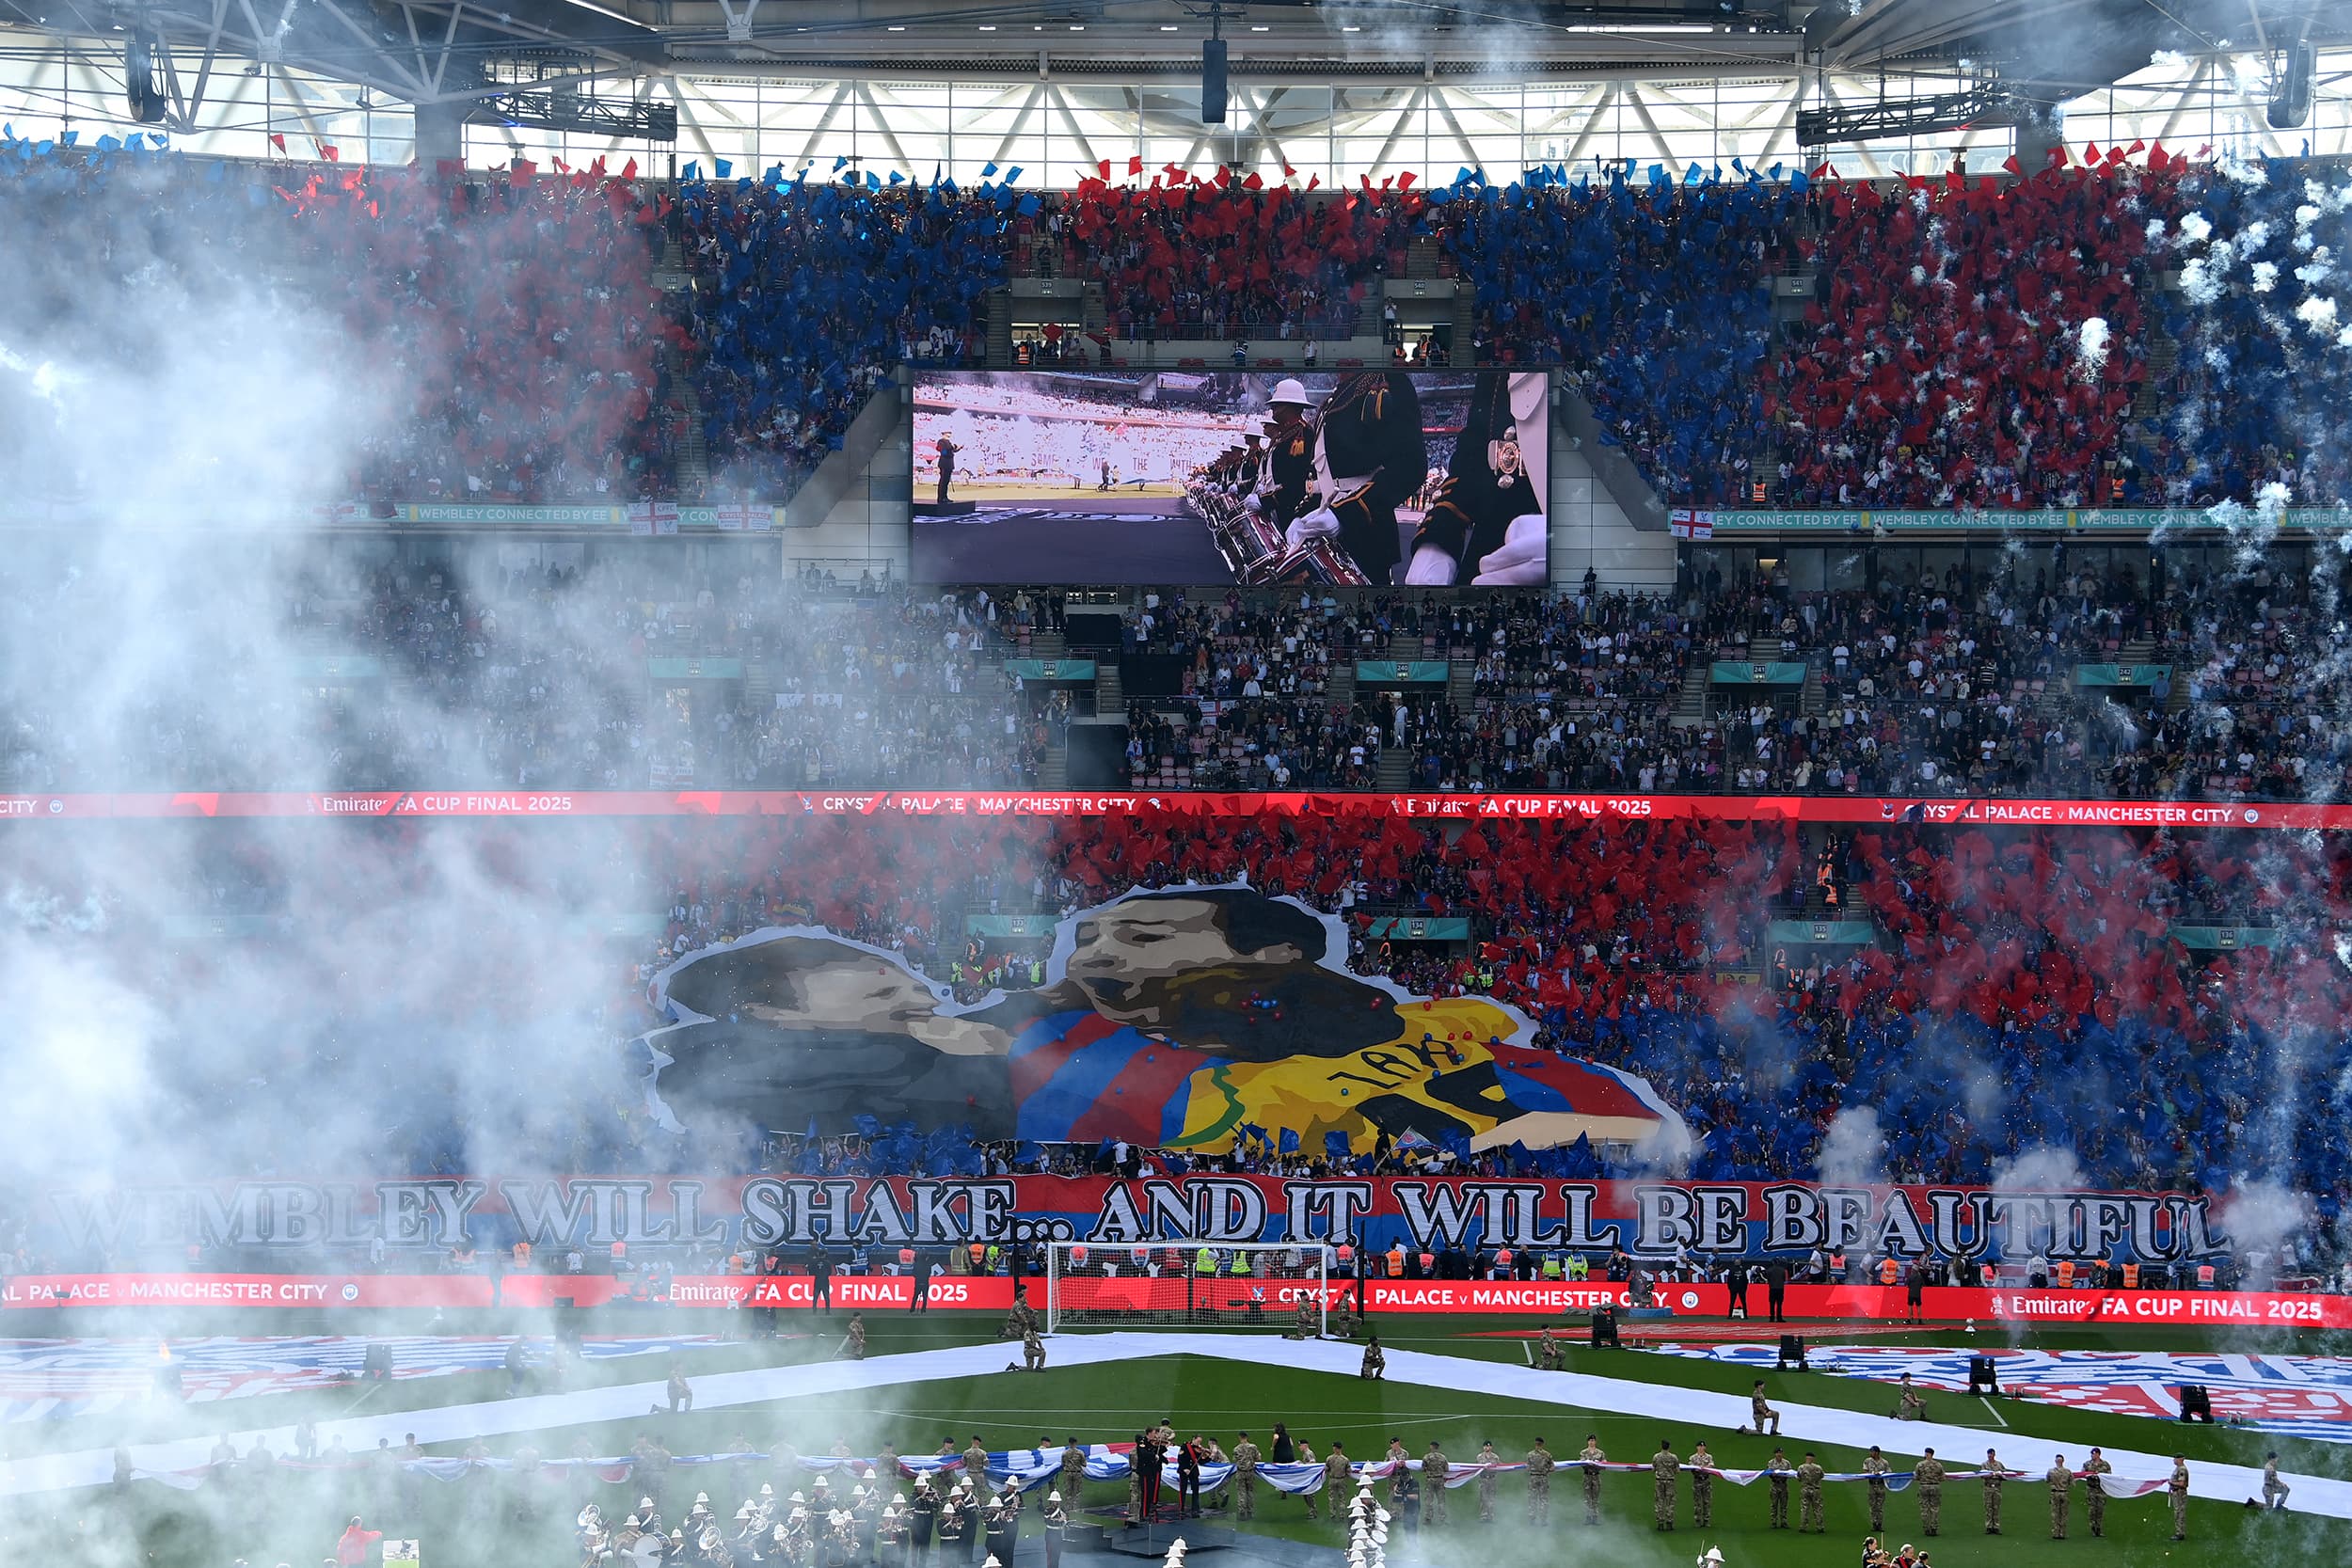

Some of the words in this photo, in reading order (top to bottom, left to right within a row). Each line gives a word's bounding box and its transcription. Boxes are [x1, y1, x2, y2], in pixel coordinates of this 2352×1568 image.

[420, 505, 483, 519] WEMBLEY
[486, 506, 570, 520] CONNECTED
[573, 508, 590, 521] BY
[593, 508, 607, 521] EE
[1737, 515, 1819, 526] CONNECTED
[1822, 515, 1840, 526] BY
[1843, 515, 1857, 527] EE
[1873, 515, 1937, 526] WEMBLEY
[1941, 515, 2026, 526] CONNECTED
[2028, 515, 2045, 526] BY
[2049, 515, 2063, 526] EE
[2079, 515, 2145, 526] WEMBLEY
[2149, 515, 2235, 526] CONNECD
[0, 800, 37, 814] CITY
[395, 797, 418, 812] FA
[423, 797, 461, 812] CUP
[468, 797, 522, 812] FINAL
[528, 796, 572, 811] 2025
[1504, 800, 1542, 814] CUP
[1985, 806, 2052, 819] PALACE
[2068, 807, 2186, 821] MANCHESTER
[2191, 809, 2233, 822] CITY
[47, 1180, 487, 1251] WEMBLEY
[500, 1180, 728, 1248] WILL
[741, 1178, 1073, 1247] SHAKE...
[1085, 1178, 1267, 1243] AND
[1281, 1180, 1373, 1245] IT
[1392, 1181, 1620, 1253] WILL
[1632, 1185, 1748, 1254] BE
[1761, 1184, 2233, 1261] BEAUTIFUL
[29, 1282, 110, 1300] PALACE
[131, 1282, 273, 1300] MANCHESTER
[279, 1283, 328, 1300] CITY
[755, 1284, 782, 1301] FA
[841, 1284, 907, 1302] FINAL
[916, 1284, 968, 1302] 025
[1375, 1289, 1454, 1306] PALACE
[1459, 1295, 1468, 1306] v
[1473, 1290, 1613, 1307] MANCHESTER
[1619, 1291, 1669, 1307] CY
[2102, 1297, 2130, 1316] FA
[2136, 1298, 2184, 1316] CUP
[2190, 1298, 2260, 1318] FINAL
[2267, 1300, 2322, 1320] 2025
